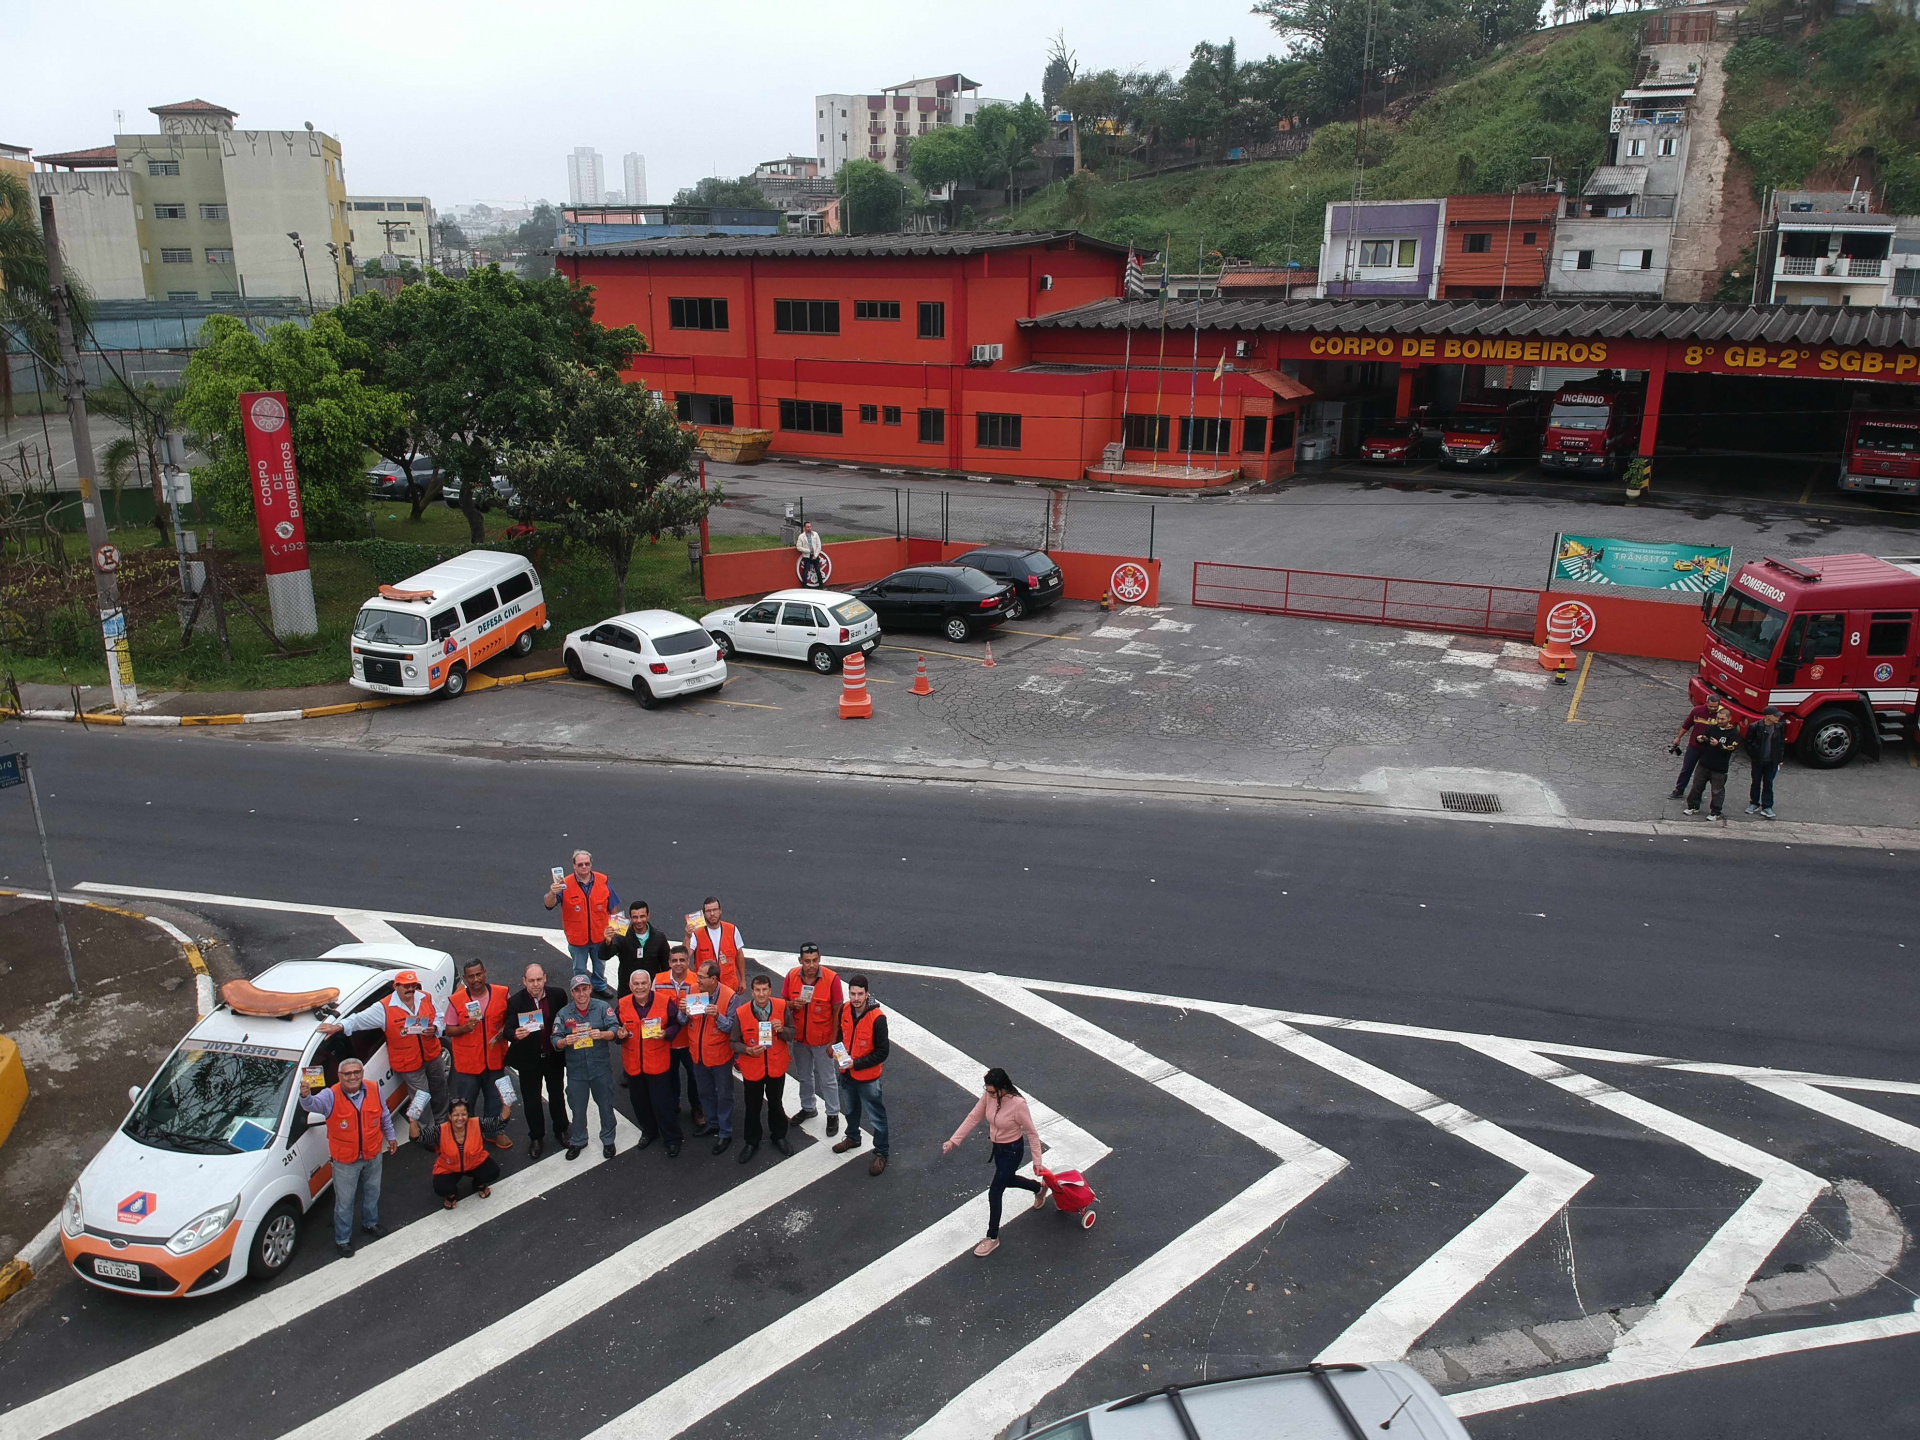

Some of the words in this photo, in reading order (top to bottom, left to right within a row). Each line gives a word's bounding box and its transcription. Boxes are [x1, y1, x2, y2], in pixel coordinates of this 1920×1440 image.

[1309, 336, 1394, 356] CORPO
[1401, 338, 1436, 357] DE
[1444, 338, 1607, 363] BOMBEIROS
[258, 460, 273, 506] CORPO
[272, 473, 283, 490] DE
[281, 442, 300, 518] BOMBEIROS
[281, 541, 304, 552] 193
[1614, 551, 1668, 563] TRÂNSITO
[1739, 572, 1786, 602] BOMBEIROS
[477, 614, 503, 635] DEFESA
[504, 604, 522, 620] CIVIL
[1850, 631, 1861, 646] 8
[437, 975, 448, 989] 199
[282, 1149, 298, 1167] 281
[97, 1264, 113, 1275] EGI
[115, 1267, 137, 1279] 2065
